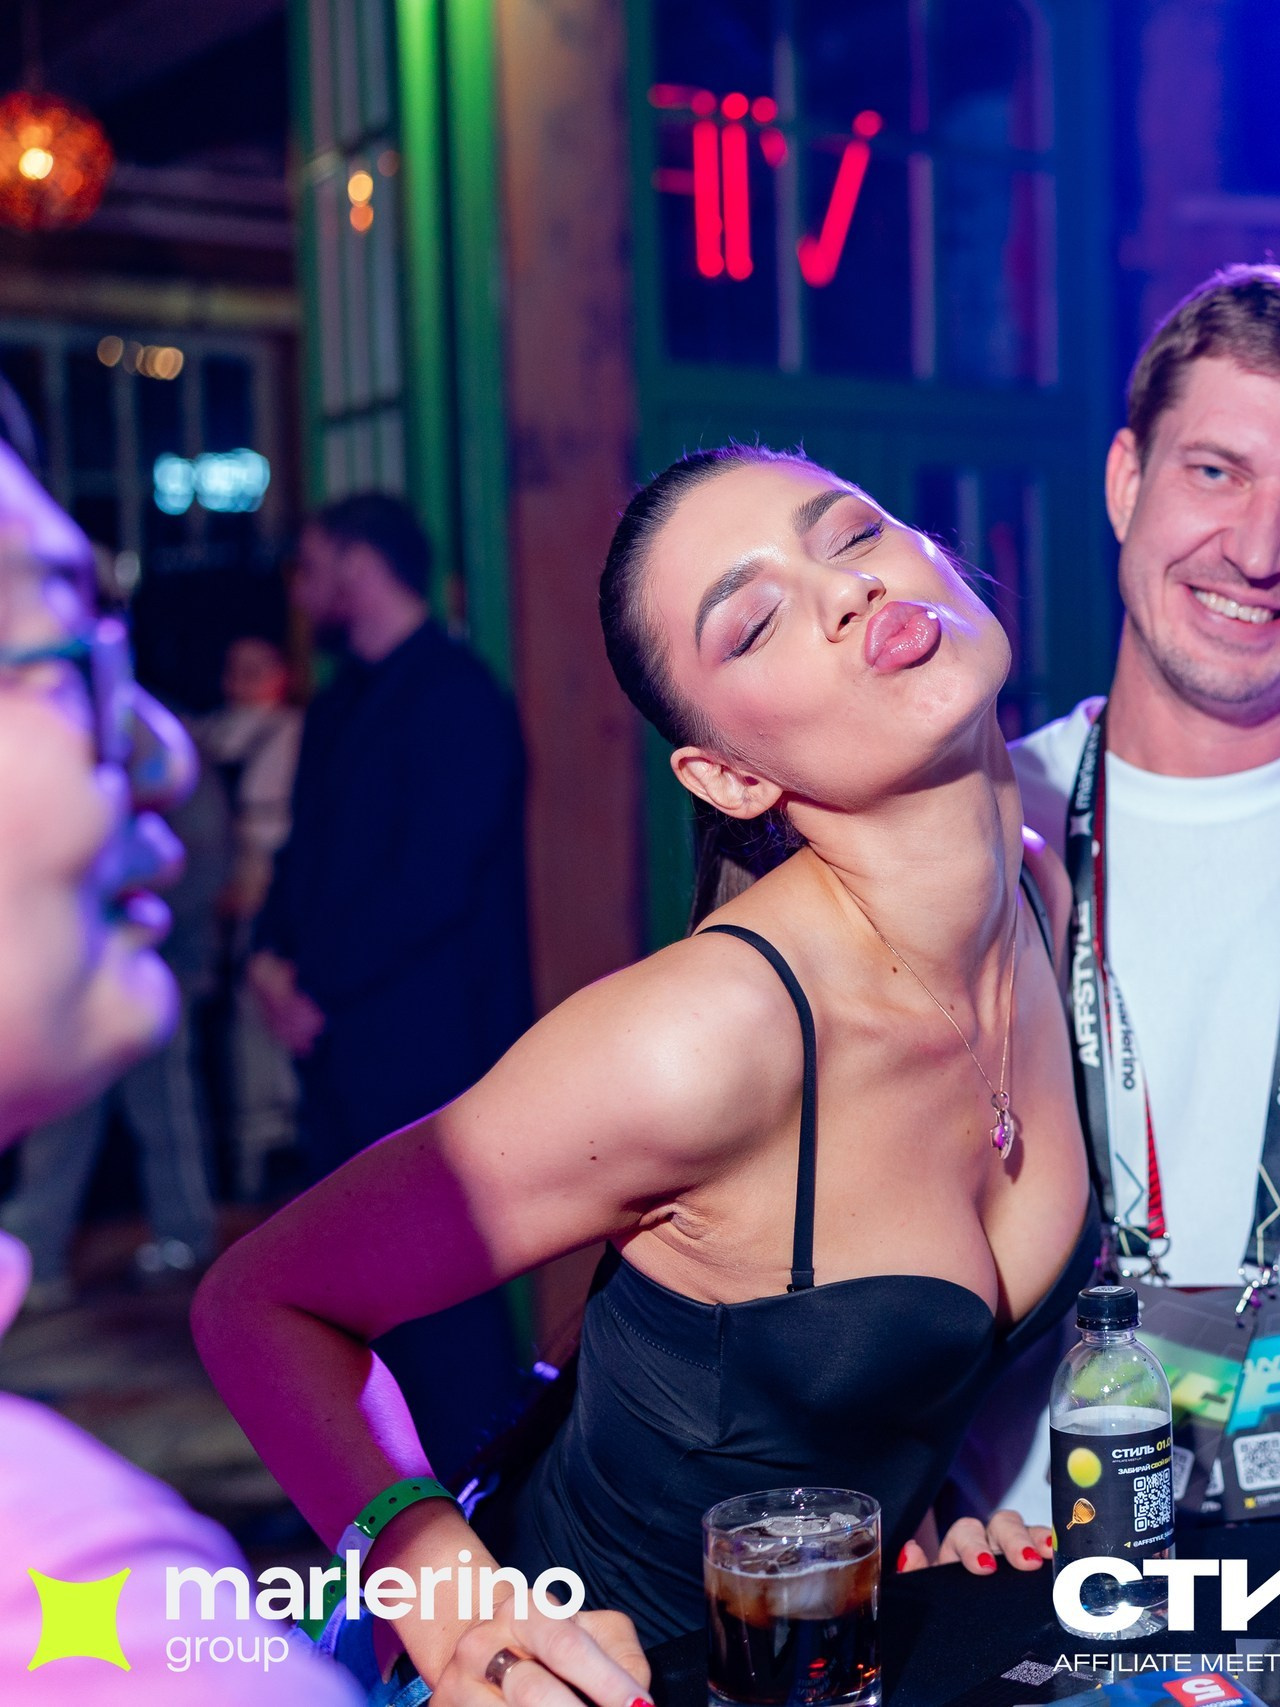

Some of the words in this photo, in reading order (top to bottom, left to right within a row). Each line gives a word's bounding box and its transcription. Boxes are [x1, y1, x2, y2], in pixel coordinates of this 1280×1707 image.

[1072, 899, 1101, 1069] AFFSTYLE
[1111, 1444, 1155, 1459] СТИЛЬ
[1118, 1463, 1151, 1475] ЗАБИРАЙ
